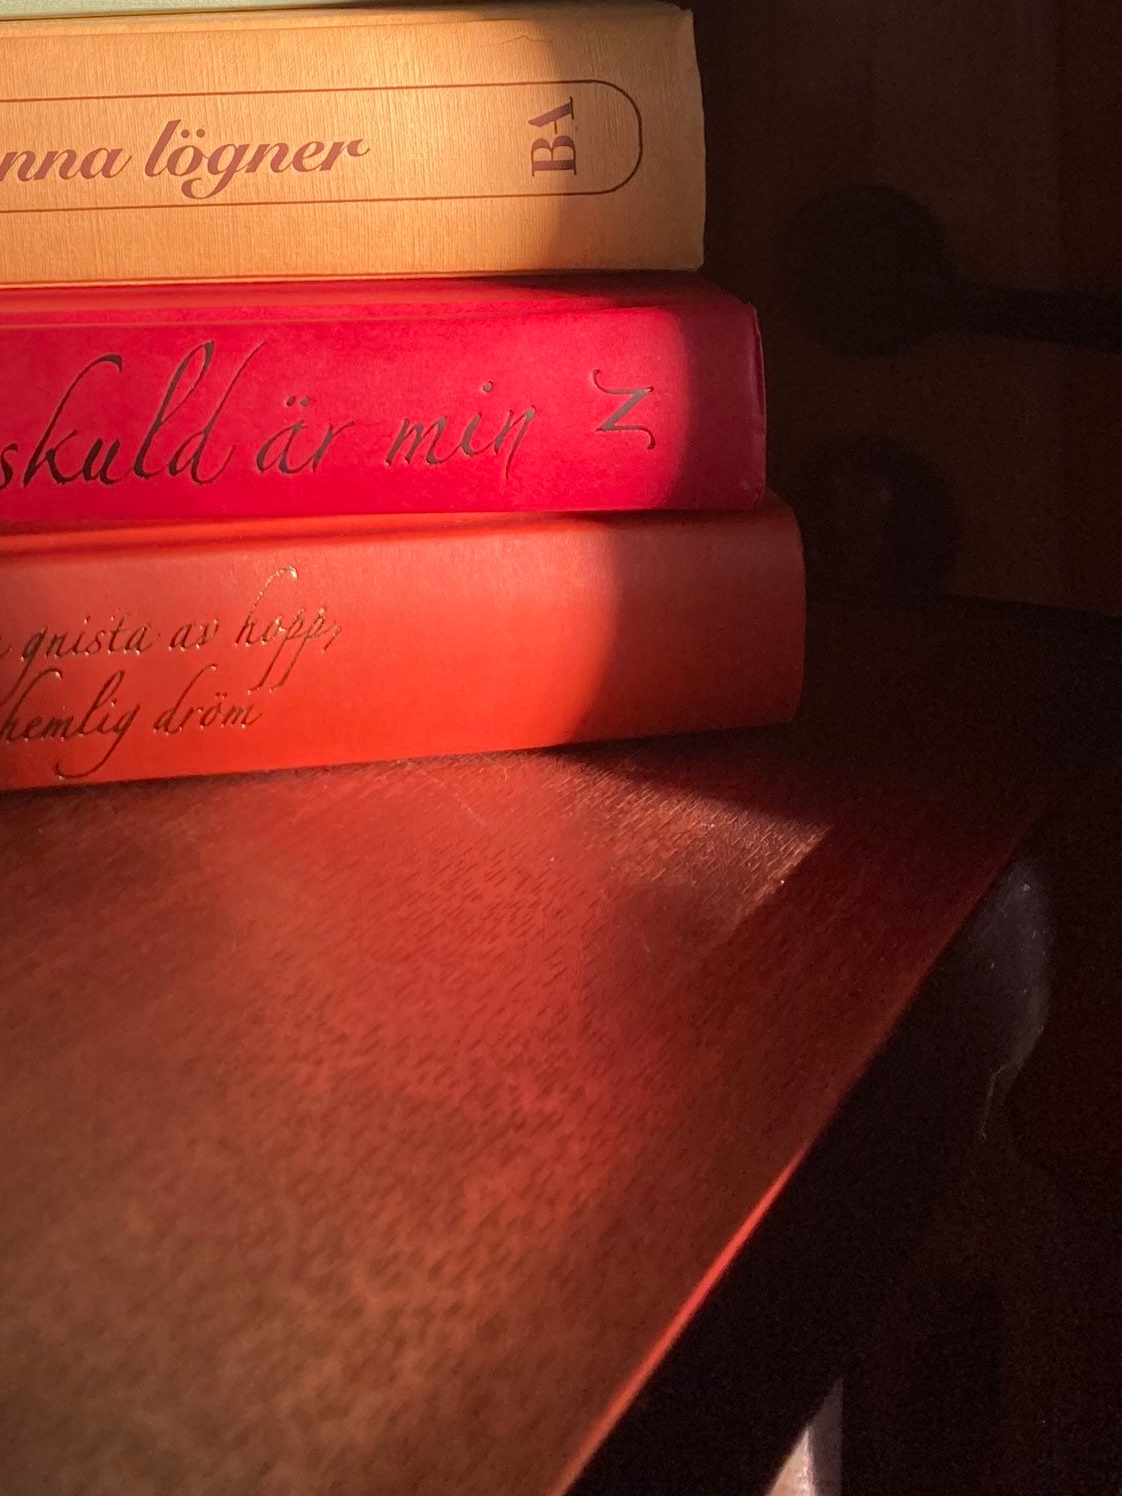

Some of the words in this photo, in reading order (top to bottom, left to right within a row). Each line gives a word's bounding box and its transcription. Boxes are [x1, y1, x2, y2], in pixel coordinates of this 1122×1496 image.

[144, 118, 370, 201] lögner
[528, 96, 577, 177] BA
[255, 394, 356, 475] är
[385, 380, 536, 482] min
[167, 618, 219, 652] av
[234, 564, 343, 695] hopp,
[152, 663, 264, 736] dröm
